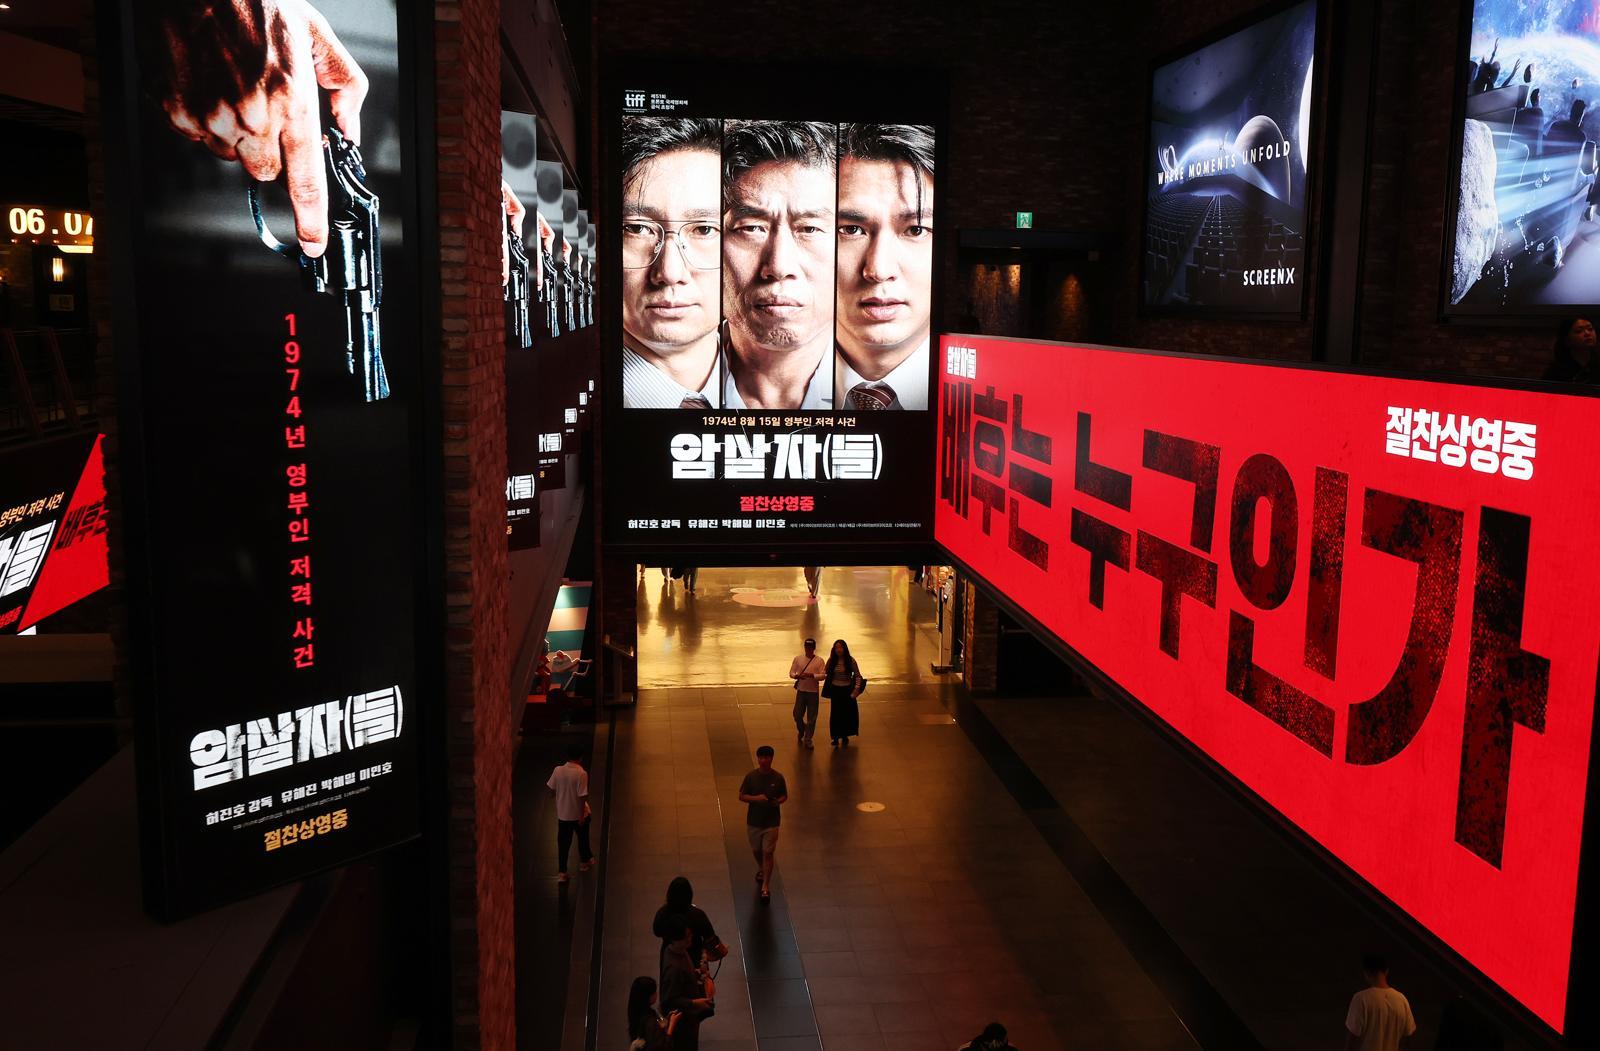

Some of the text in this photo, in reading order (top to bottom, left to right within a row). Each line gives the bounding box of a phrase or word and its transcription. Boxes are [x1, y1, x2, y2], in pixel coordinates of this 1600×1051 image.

[625, 94, 645, 107] tiff
[1158, 141, 1290, 185] WHERE MOMENTS UNFOLD
[1243, 267, 1295, 285] SCREENX
[702, 417, 856, 427] 1974년 8월 15일 영부인 저격 사건
[1386, 406, 1537, 481] 절찬상영중
[670, 433, 883, 480] 암살자(들)
[0, 491, 65, 528] 영부인 저격 사건
[284, 313, 315, 668] 1974년 영부인 저격 사건
[740, 496, 815, 512] 절찬상영중
[627, 519, 659, 529] 허진호
[661, 519, 681, 529] 감독
[688, 519, 718, 529] 유해진
[722, 519, 752, 529] 박해일
[941, 382, 1551, 872] 배후는 누구인가
[190, 685, 403, 791] 암살자(들)
[206, 803, 246, 826] 허진호
[248, 796, 273, 812] 감독
[281, 783, 317, 804] 유해진
[321, 771, 356, 791] 박해일
[264, 809, 348, 852] 절찬상영중
